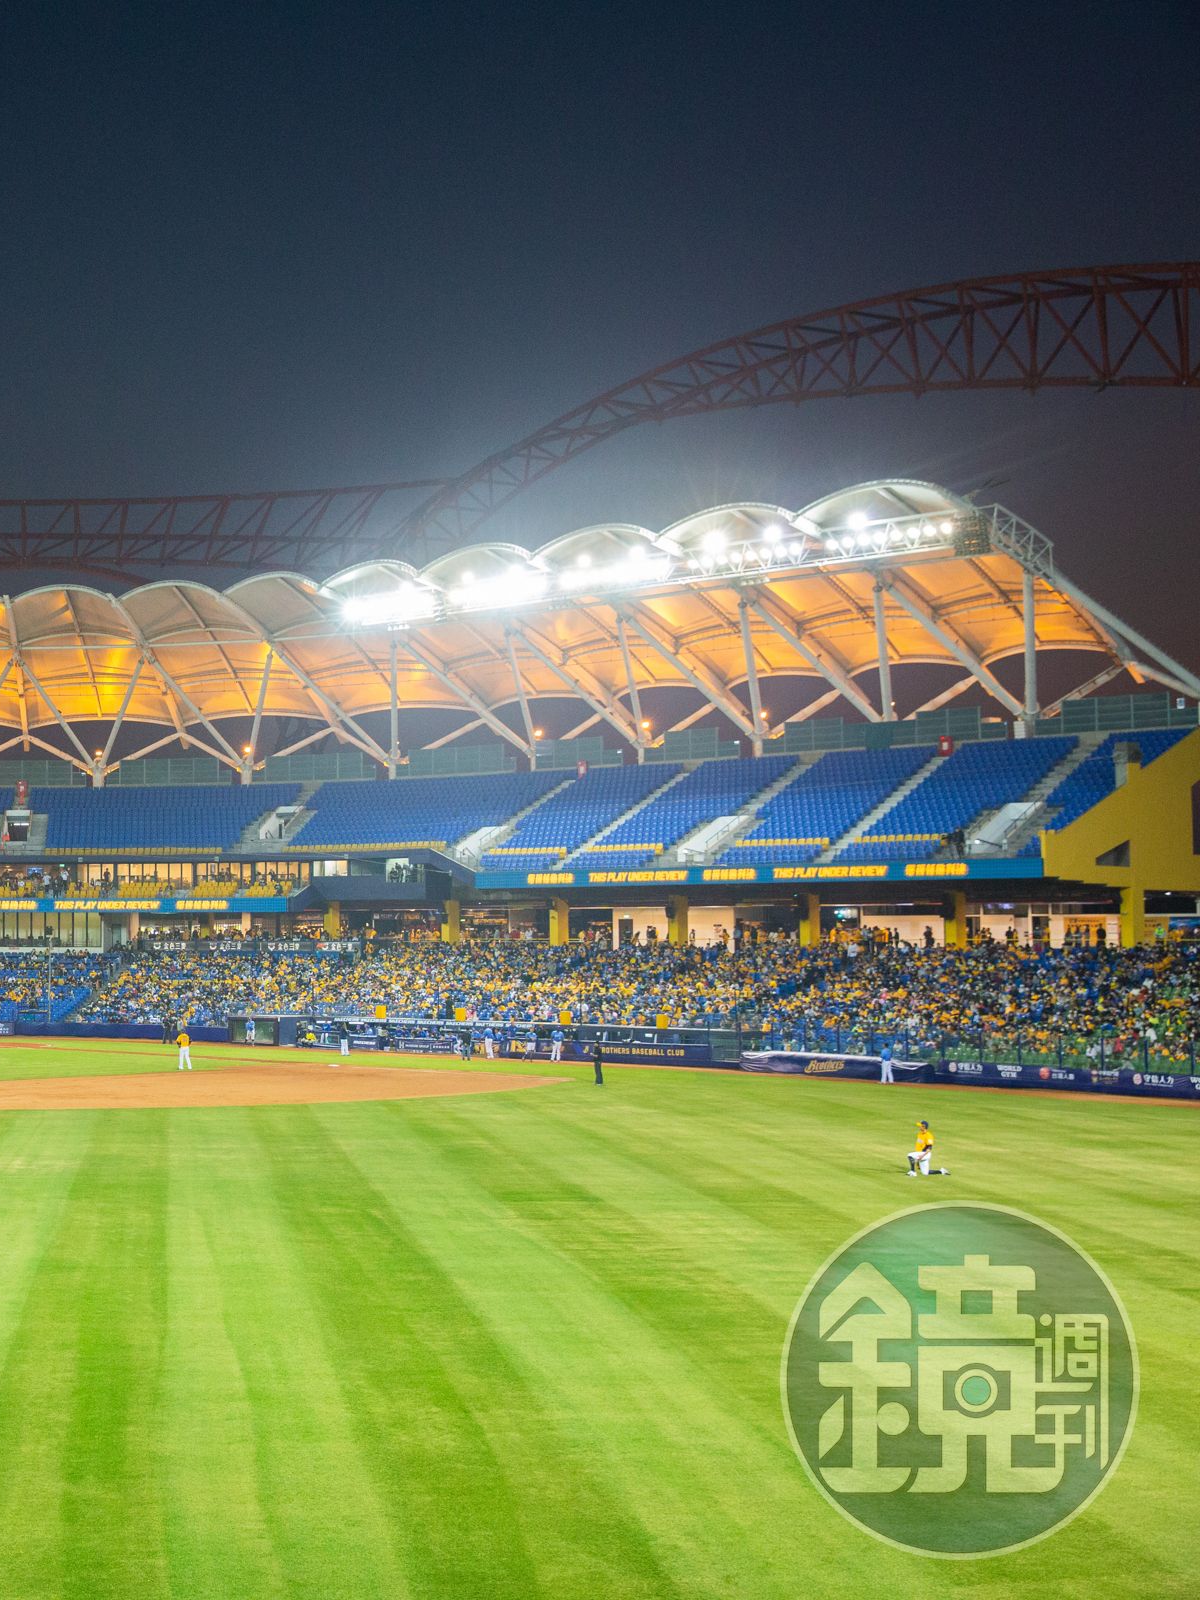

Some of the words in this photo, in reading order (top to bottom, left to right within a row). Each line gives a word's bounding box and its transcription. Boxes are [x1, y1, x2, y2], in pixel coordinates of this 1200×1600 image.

[589, 872, 607, 882] THIS
[607, 872, 628, 882] PLAY
[628, 871, 654, 881] UNDER
[654, 870, 688, 880] REVIEW
[773, 868, 794, 878] THIS
[794, 867, 818, 878] PLAY
[818, 866, 849, 877] UNDER
[849, 865, 888, 877] REVIEW
[55, 901, 74, 909] THIS
[74, 901, 97, 909] PLAY
[97, 901, 126, 909] UNDER
[126, 901, 160, 910] REVIEW
[631, 1047, 664, 1056] BASEBALL
